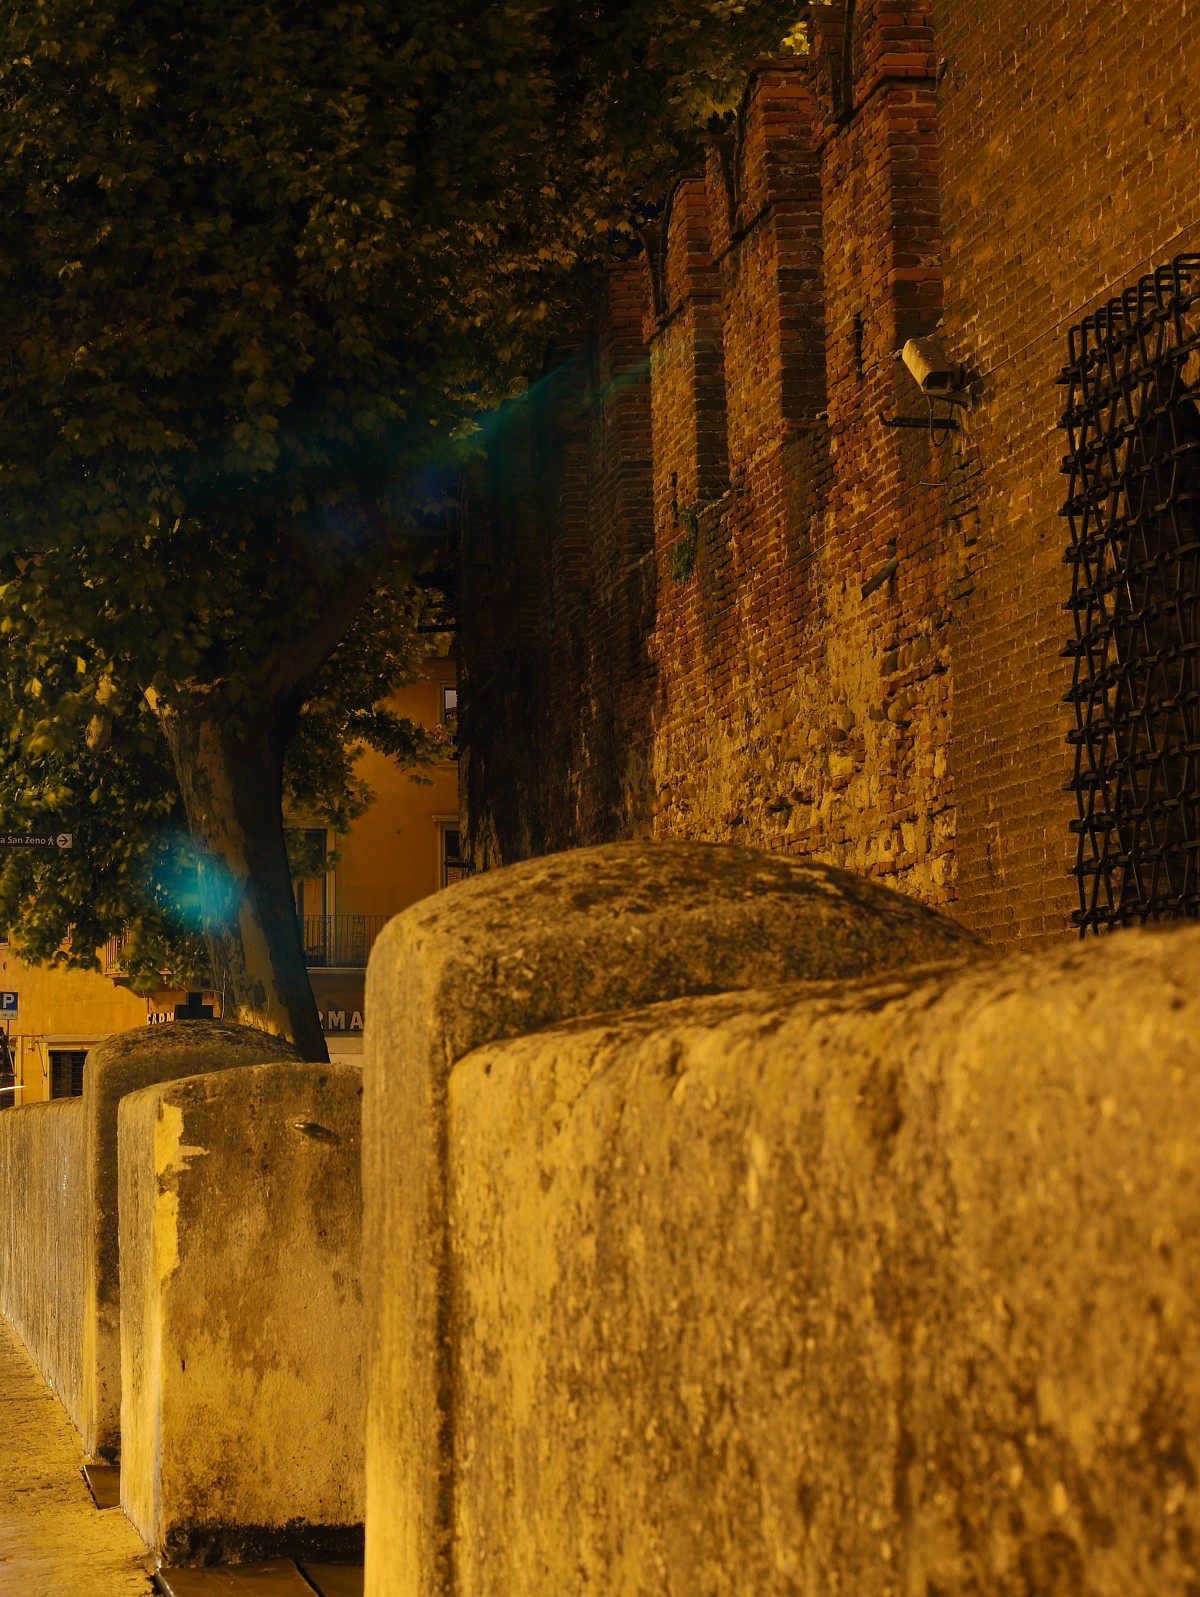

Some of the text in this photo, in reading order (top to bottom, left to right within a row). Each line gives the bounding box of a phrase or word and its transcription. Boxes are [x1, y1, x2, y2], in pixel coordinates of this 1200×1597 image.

[7, 836, 23, 844] San
[25, 836, 46, 845] Zeno
[2, 993, 14, 1009] P
